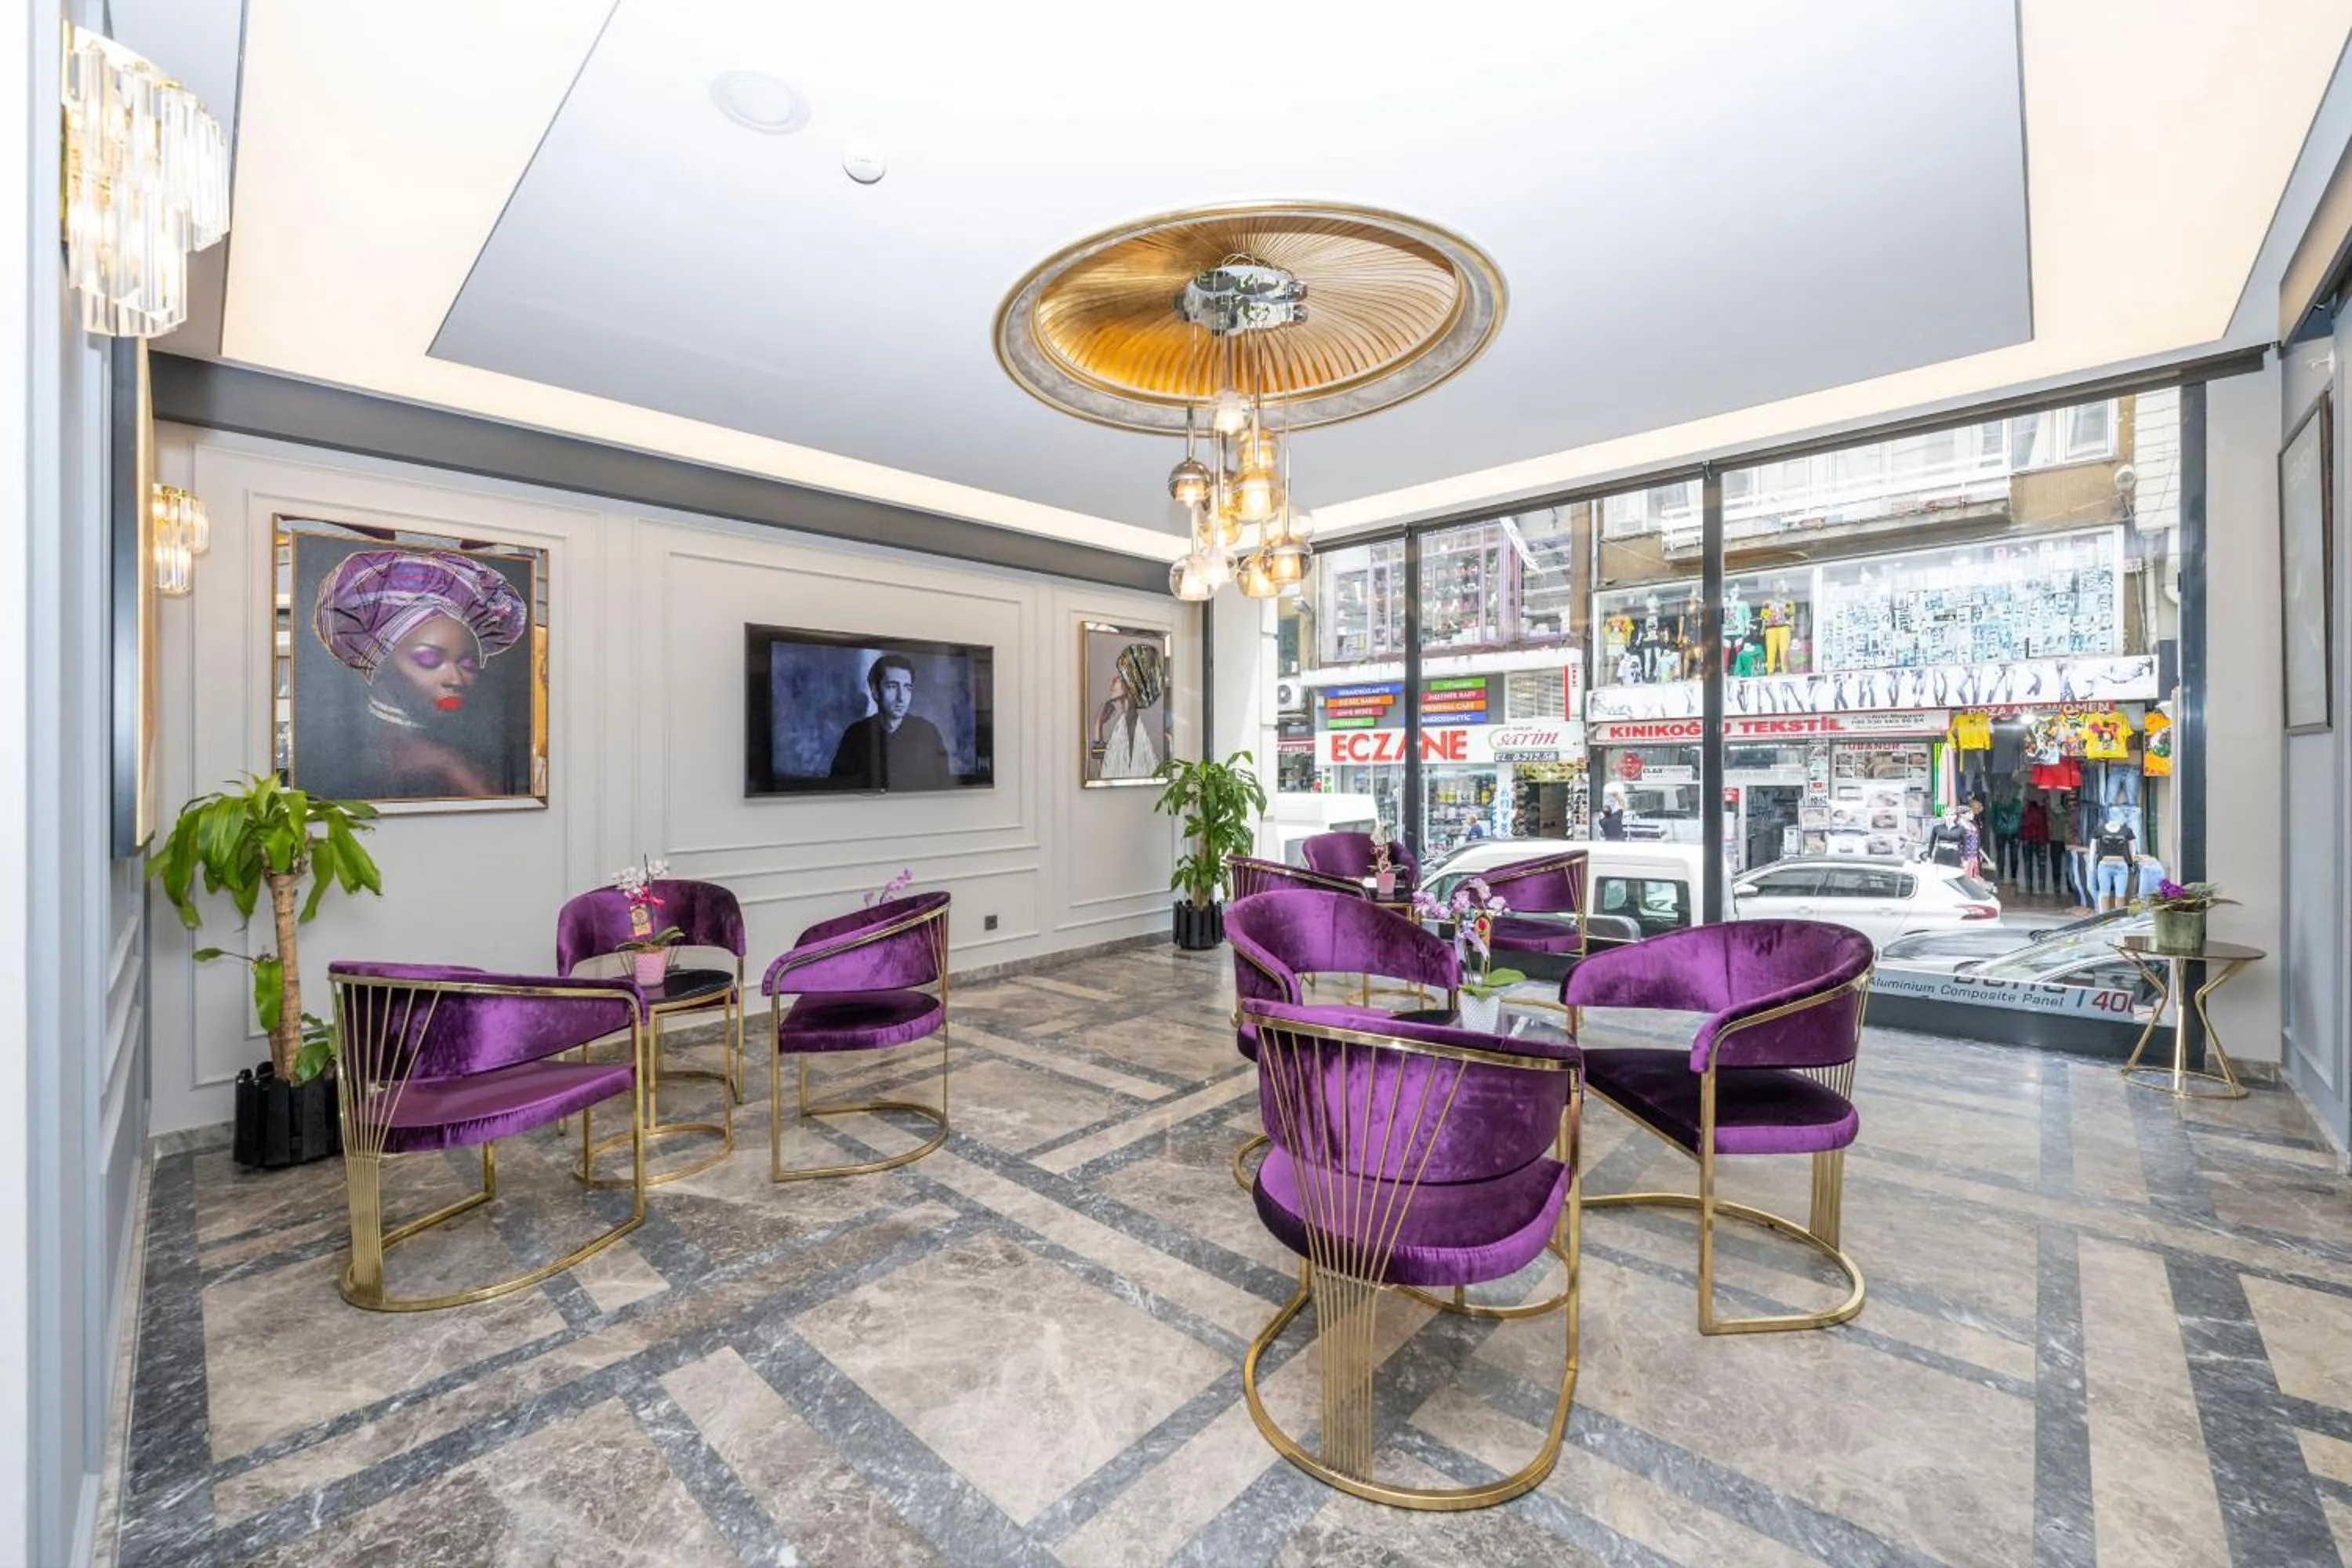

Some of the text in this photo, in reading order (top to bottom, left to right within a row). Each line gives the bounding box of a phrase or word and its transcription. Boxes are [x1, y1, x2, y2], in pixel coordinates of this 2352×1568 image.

[1610, 716, 1845, 739] KINIKOĞ TEKSTİL
[1868, 976, 1935, 993] Aluminium
[1940, 984, 2016, 1003] Composite
[2022, 993, 2064, 1007] Panel
